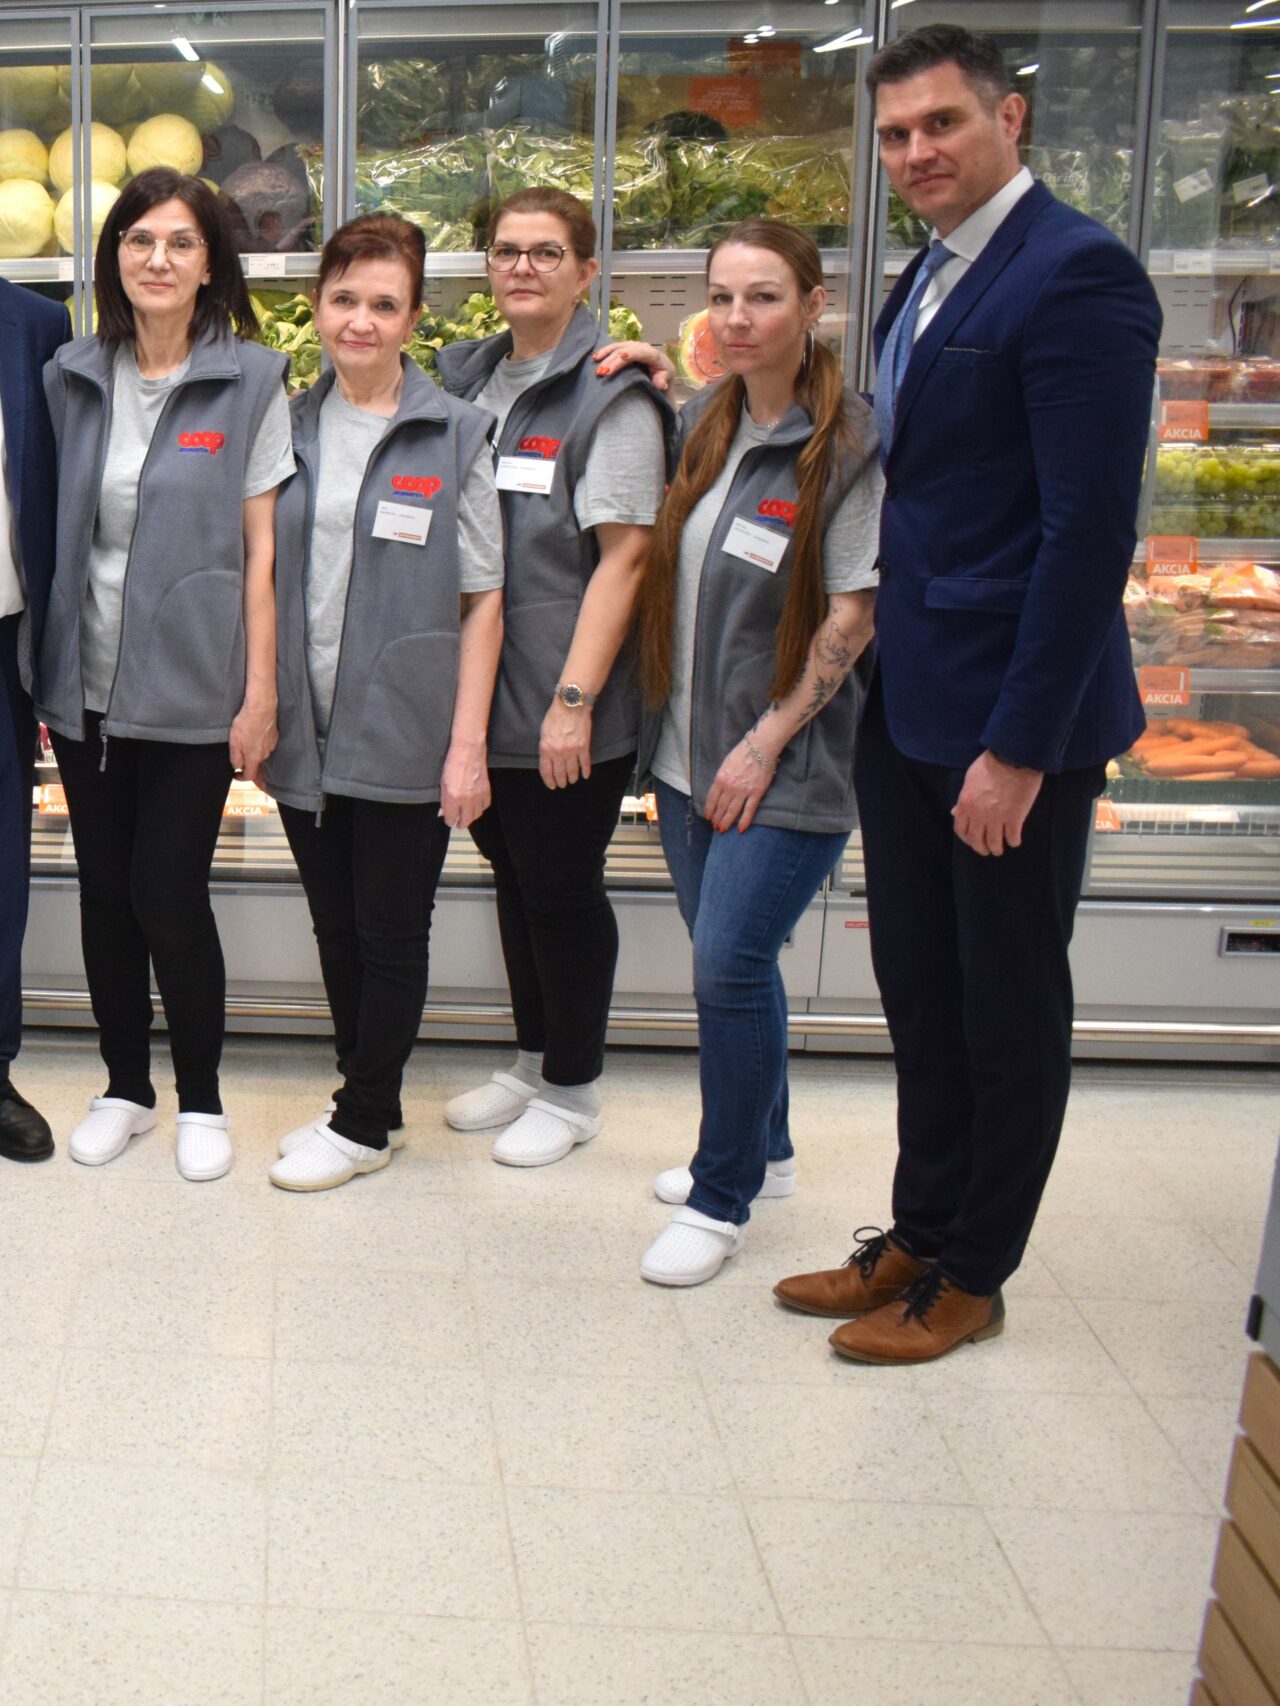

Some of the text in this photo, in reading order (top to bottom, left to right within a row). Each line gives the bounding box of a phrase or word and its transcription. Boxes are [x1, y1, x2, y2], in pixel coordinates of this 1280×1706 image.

[1163, 427, 1202, 439] AKCIA
[178, 431, 224, 455] coop
[520, 436, 561, 459] coop
[391, 475, 442, 499] coop
[1152, 563, 1191, 575] AKCIA
[1145, 693, 1183, 705] AKCIA
[44, 804, 67, 813] AKC
[226, 806, 263, 815] AKCIA
